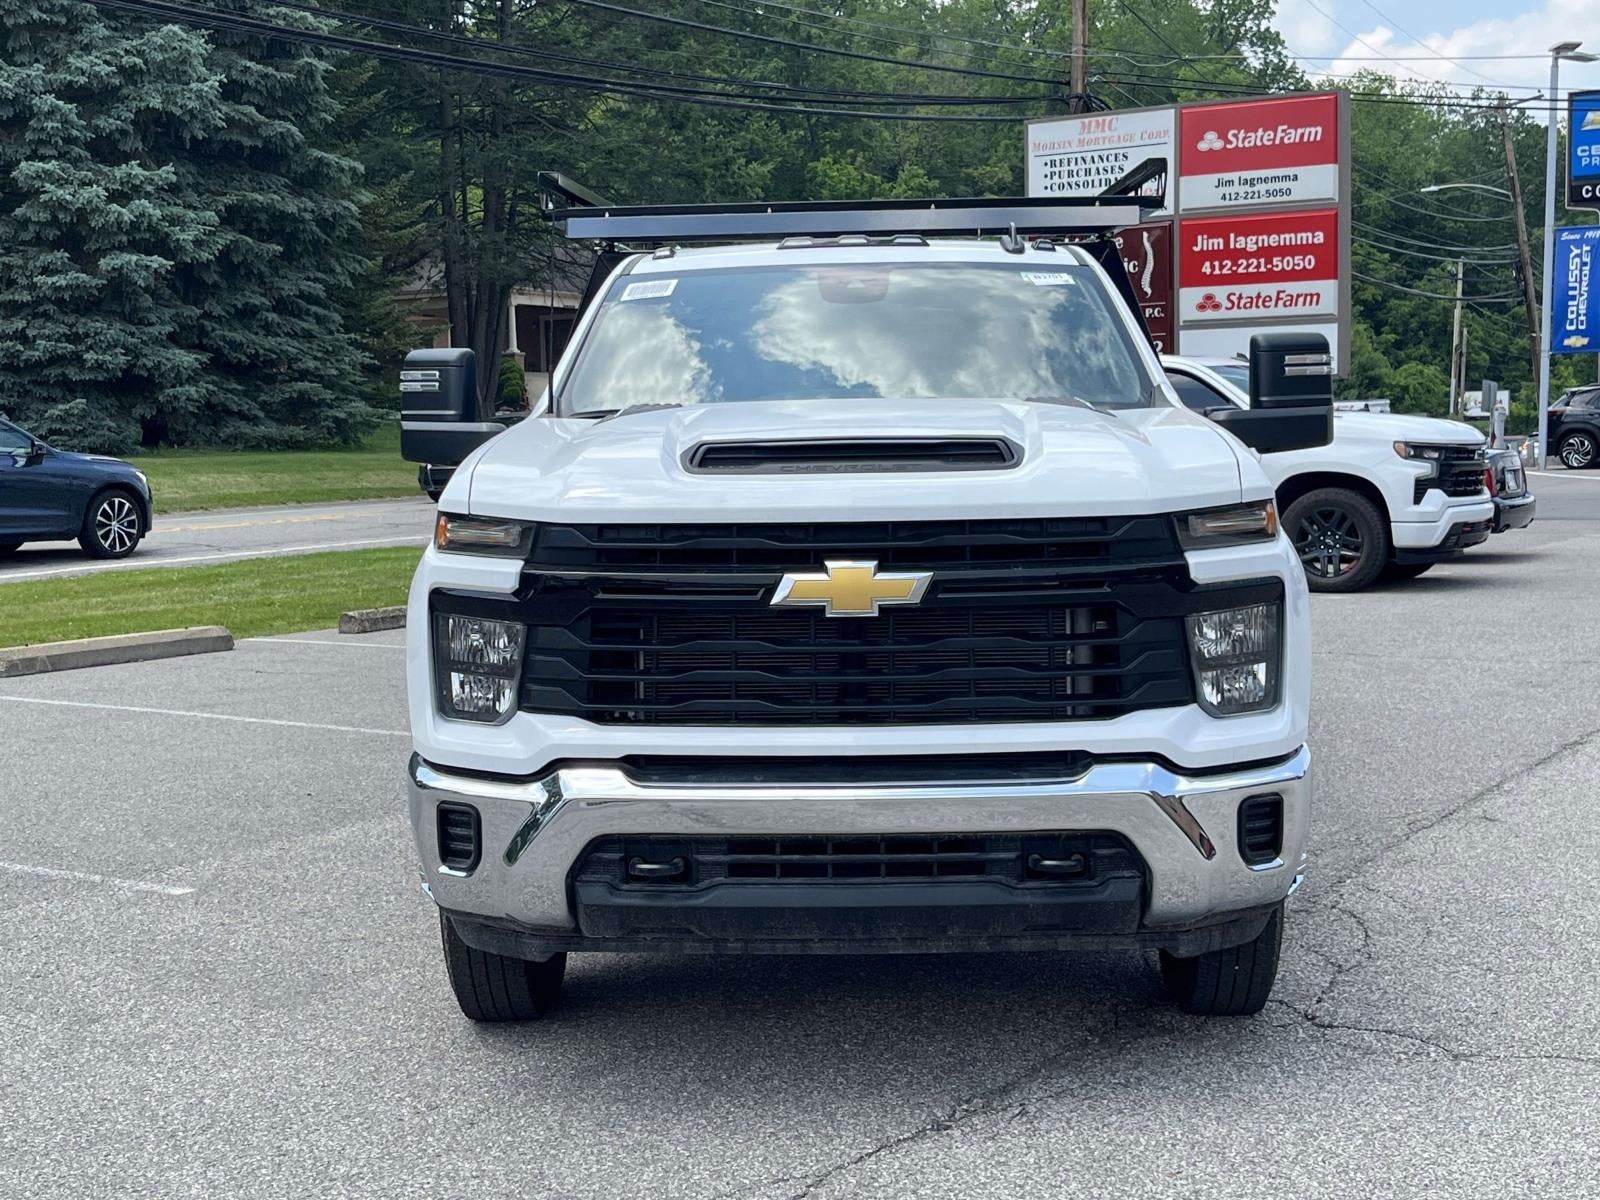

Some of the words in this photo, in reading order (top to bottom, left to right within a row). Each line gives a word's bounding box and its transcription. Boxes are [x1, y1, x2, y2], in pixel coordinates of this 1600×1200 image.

[1079, 117, 1119, 136] MMC
[1075, 133, 1137, 148] MORTGAGE
[1049, 151, 1129, 169] REFINANCES
[1049, 163, 1125, 180] PURCHASES
[1214, 176, 1235, 189] Jim
[1238, 173, 1299, 188] Iagnemma
[1220, 187, 1292, 202] 412-221-5050
[1192, 234, 1225, 252] Jim
[1229, 230, 1324, 252] Iagnemma
[1201, 254, 1316, 275] 412-221-5050
[1566, 245, 1581, 331] COLUSSY
[1577, 243, 1591, 330] CHEVROLET
